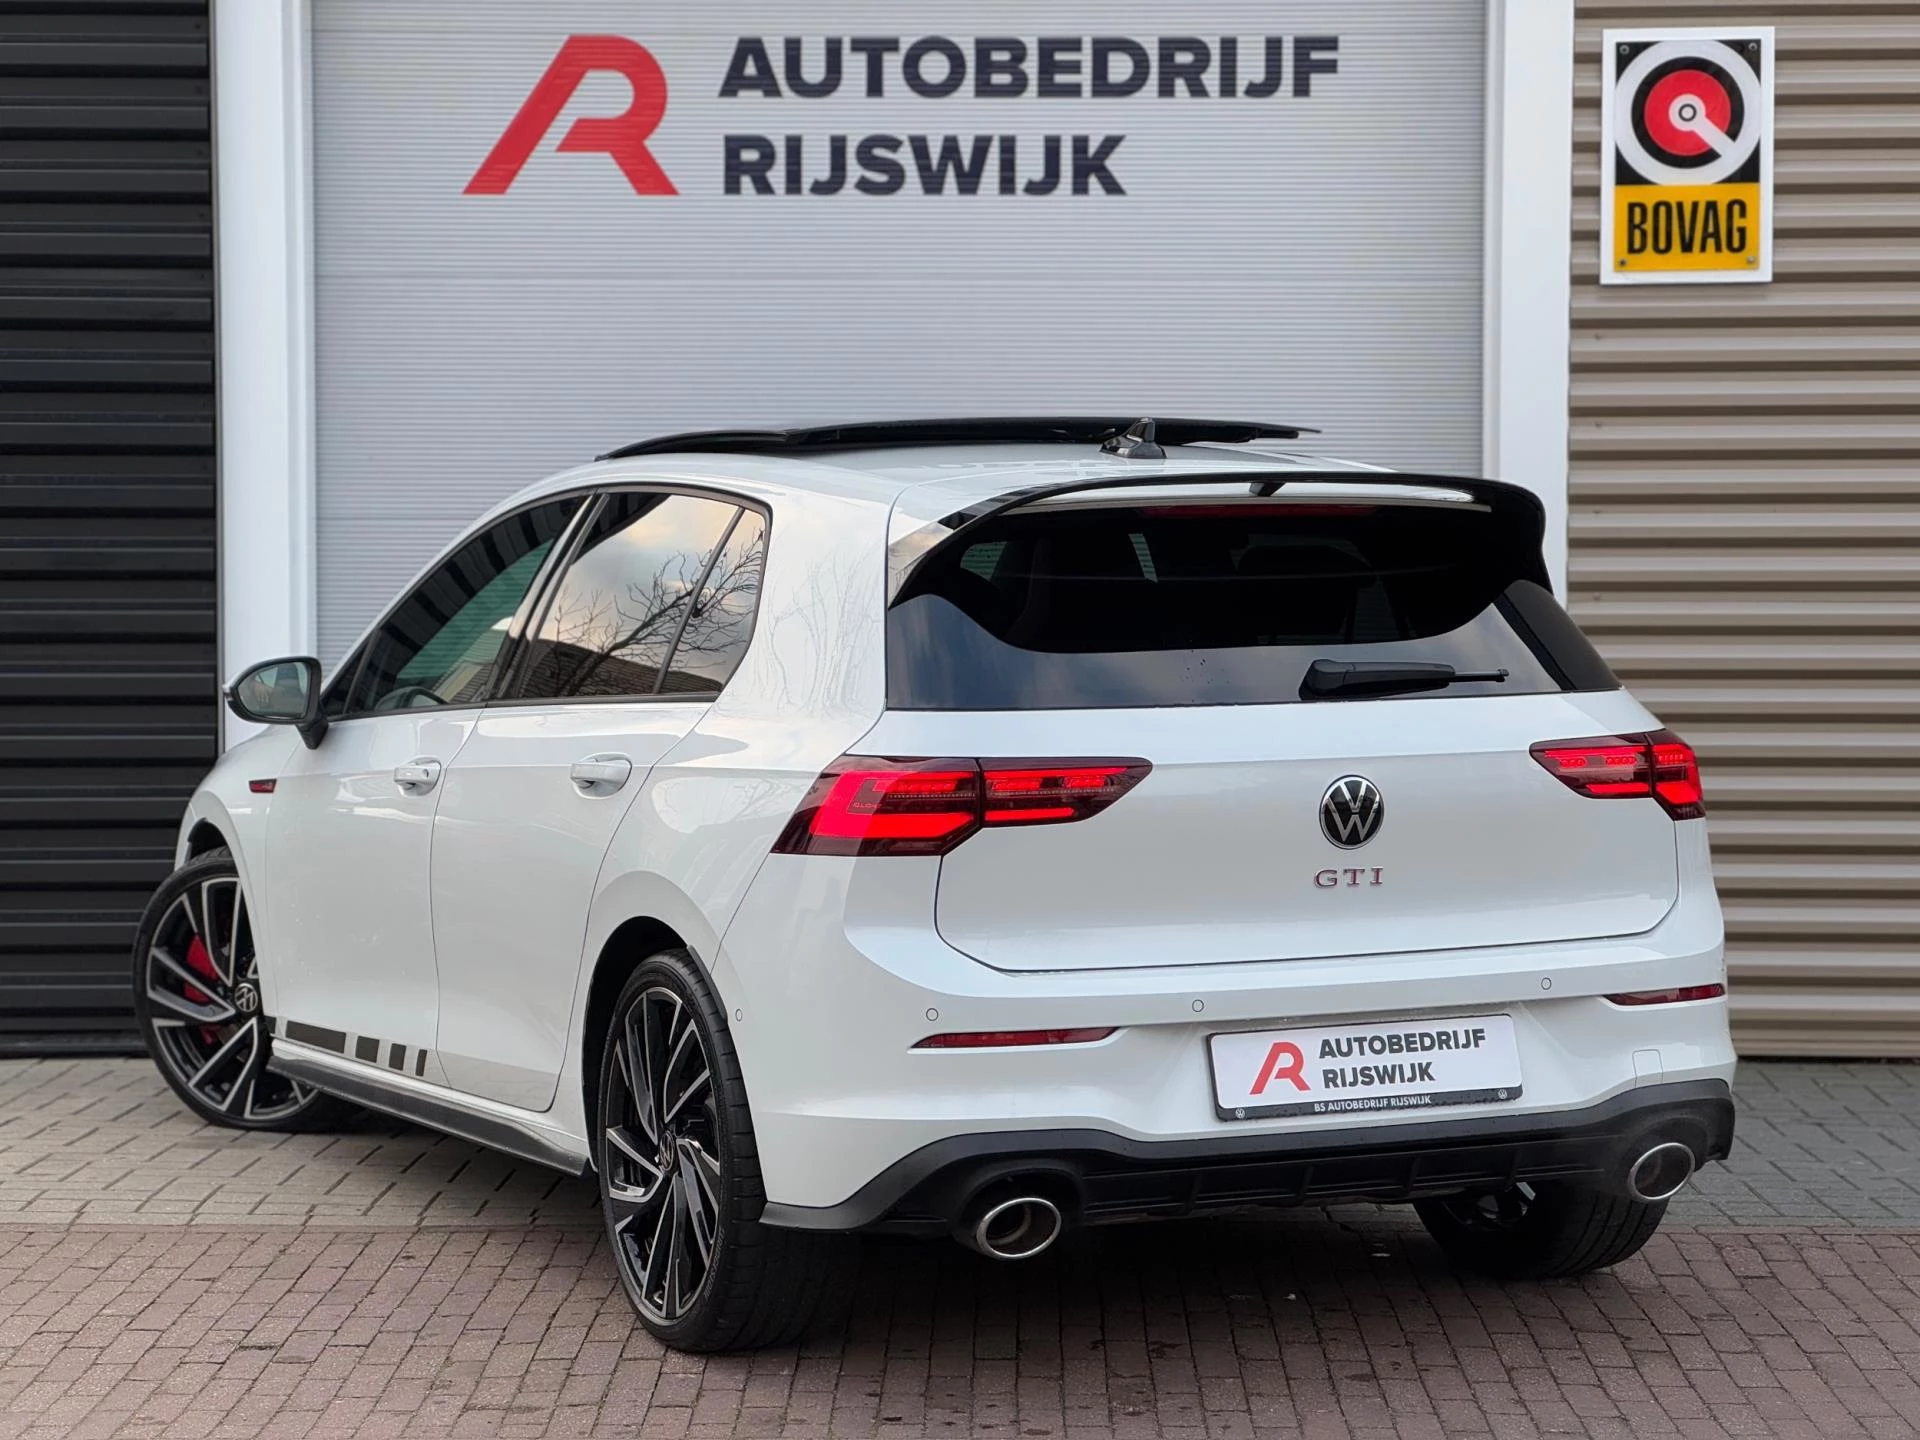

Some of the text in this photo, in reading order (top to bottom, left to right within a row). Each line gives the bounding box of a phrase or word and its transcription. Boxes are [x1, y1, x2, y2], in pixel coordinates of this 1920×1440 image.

[718, 36, 1339, 98] AUTOBEDRIJF
[723, 134, 1127, 196] RIJSWIJK
[1627, 199, 1747, 254] BOVAG
[1314, 867, 1384, 888] GTI
[1319, 1028, 1486, 1059] AUTOBEDRIJF
[1322, 1061, 1436, 1089] RIJSWIJK
[1314, 1095, 1432, 1112] BS AUTOBEDRIJF RIJSWIJK
